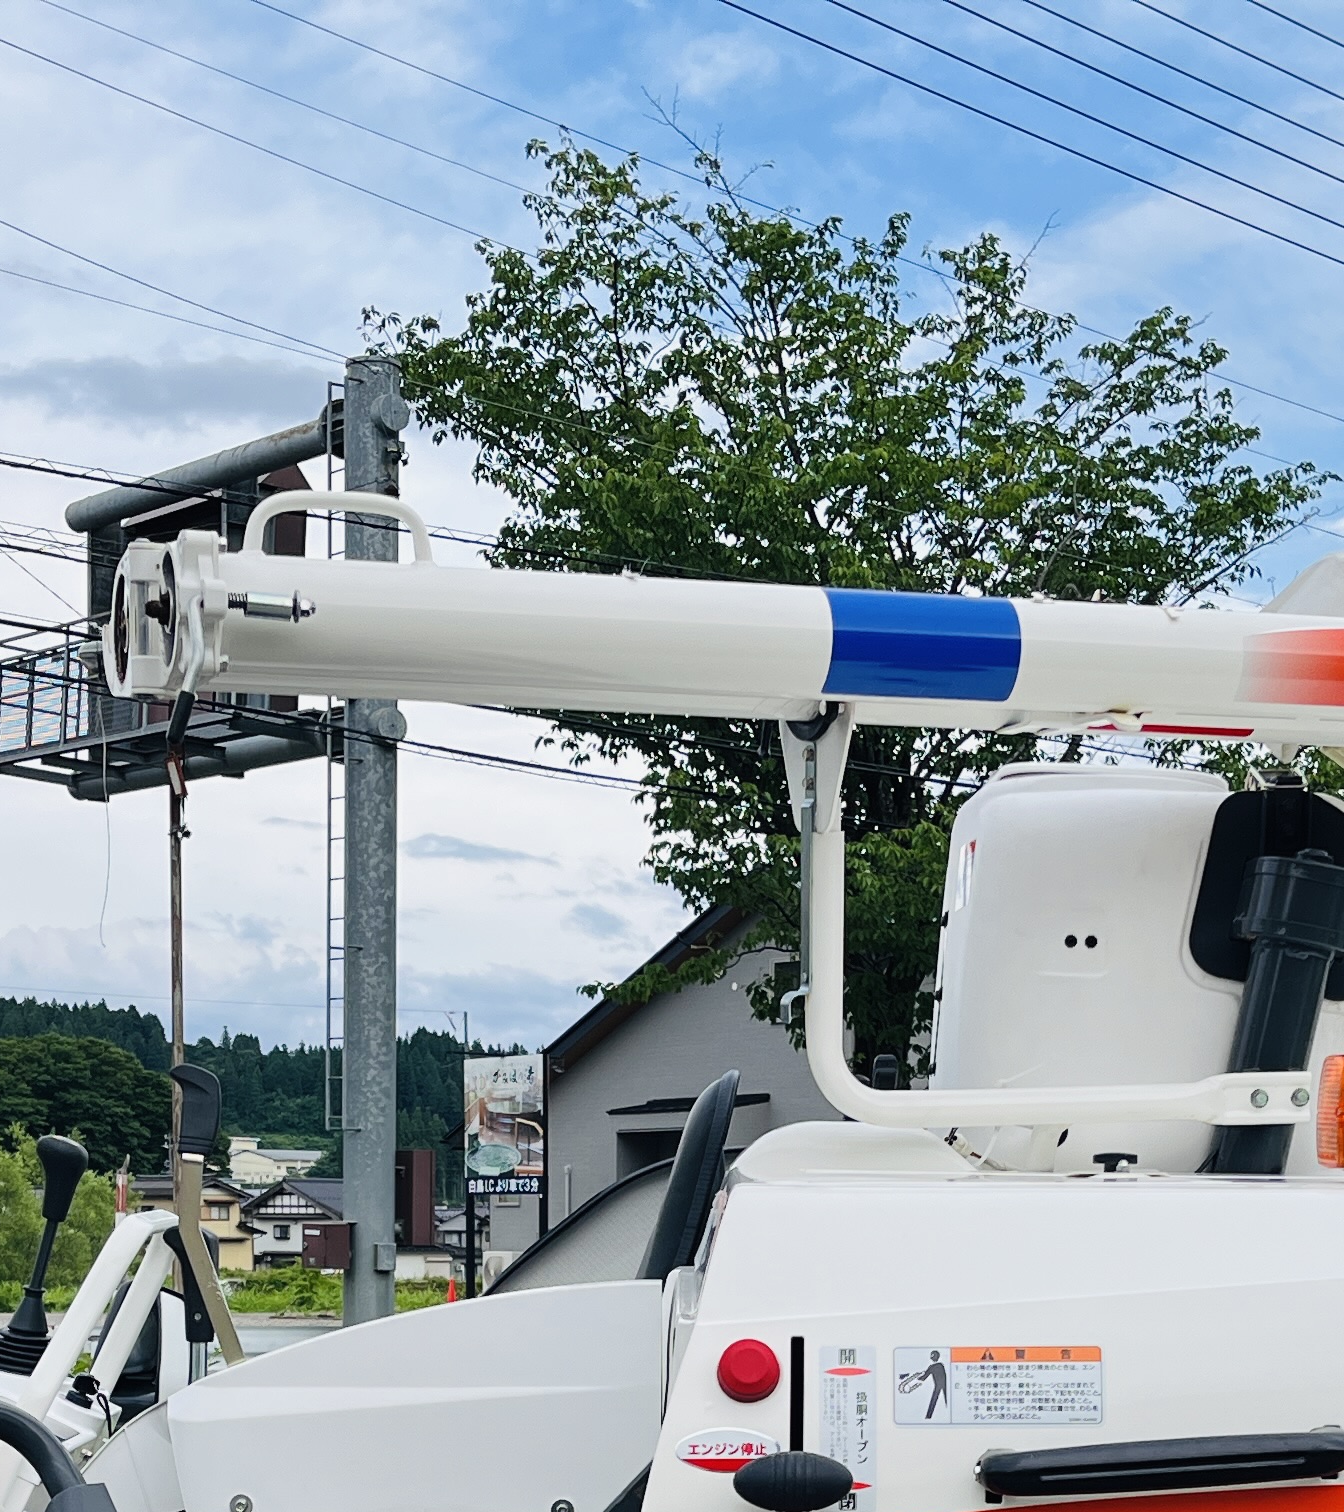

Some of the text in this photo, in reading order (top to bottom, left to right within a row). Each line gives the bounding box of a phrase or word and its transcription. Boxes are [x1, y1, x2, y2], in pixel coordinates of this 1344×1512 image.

[839, 1348, 857, 1366] 開
[687, 1442, 768, 1456] エンジン停止
